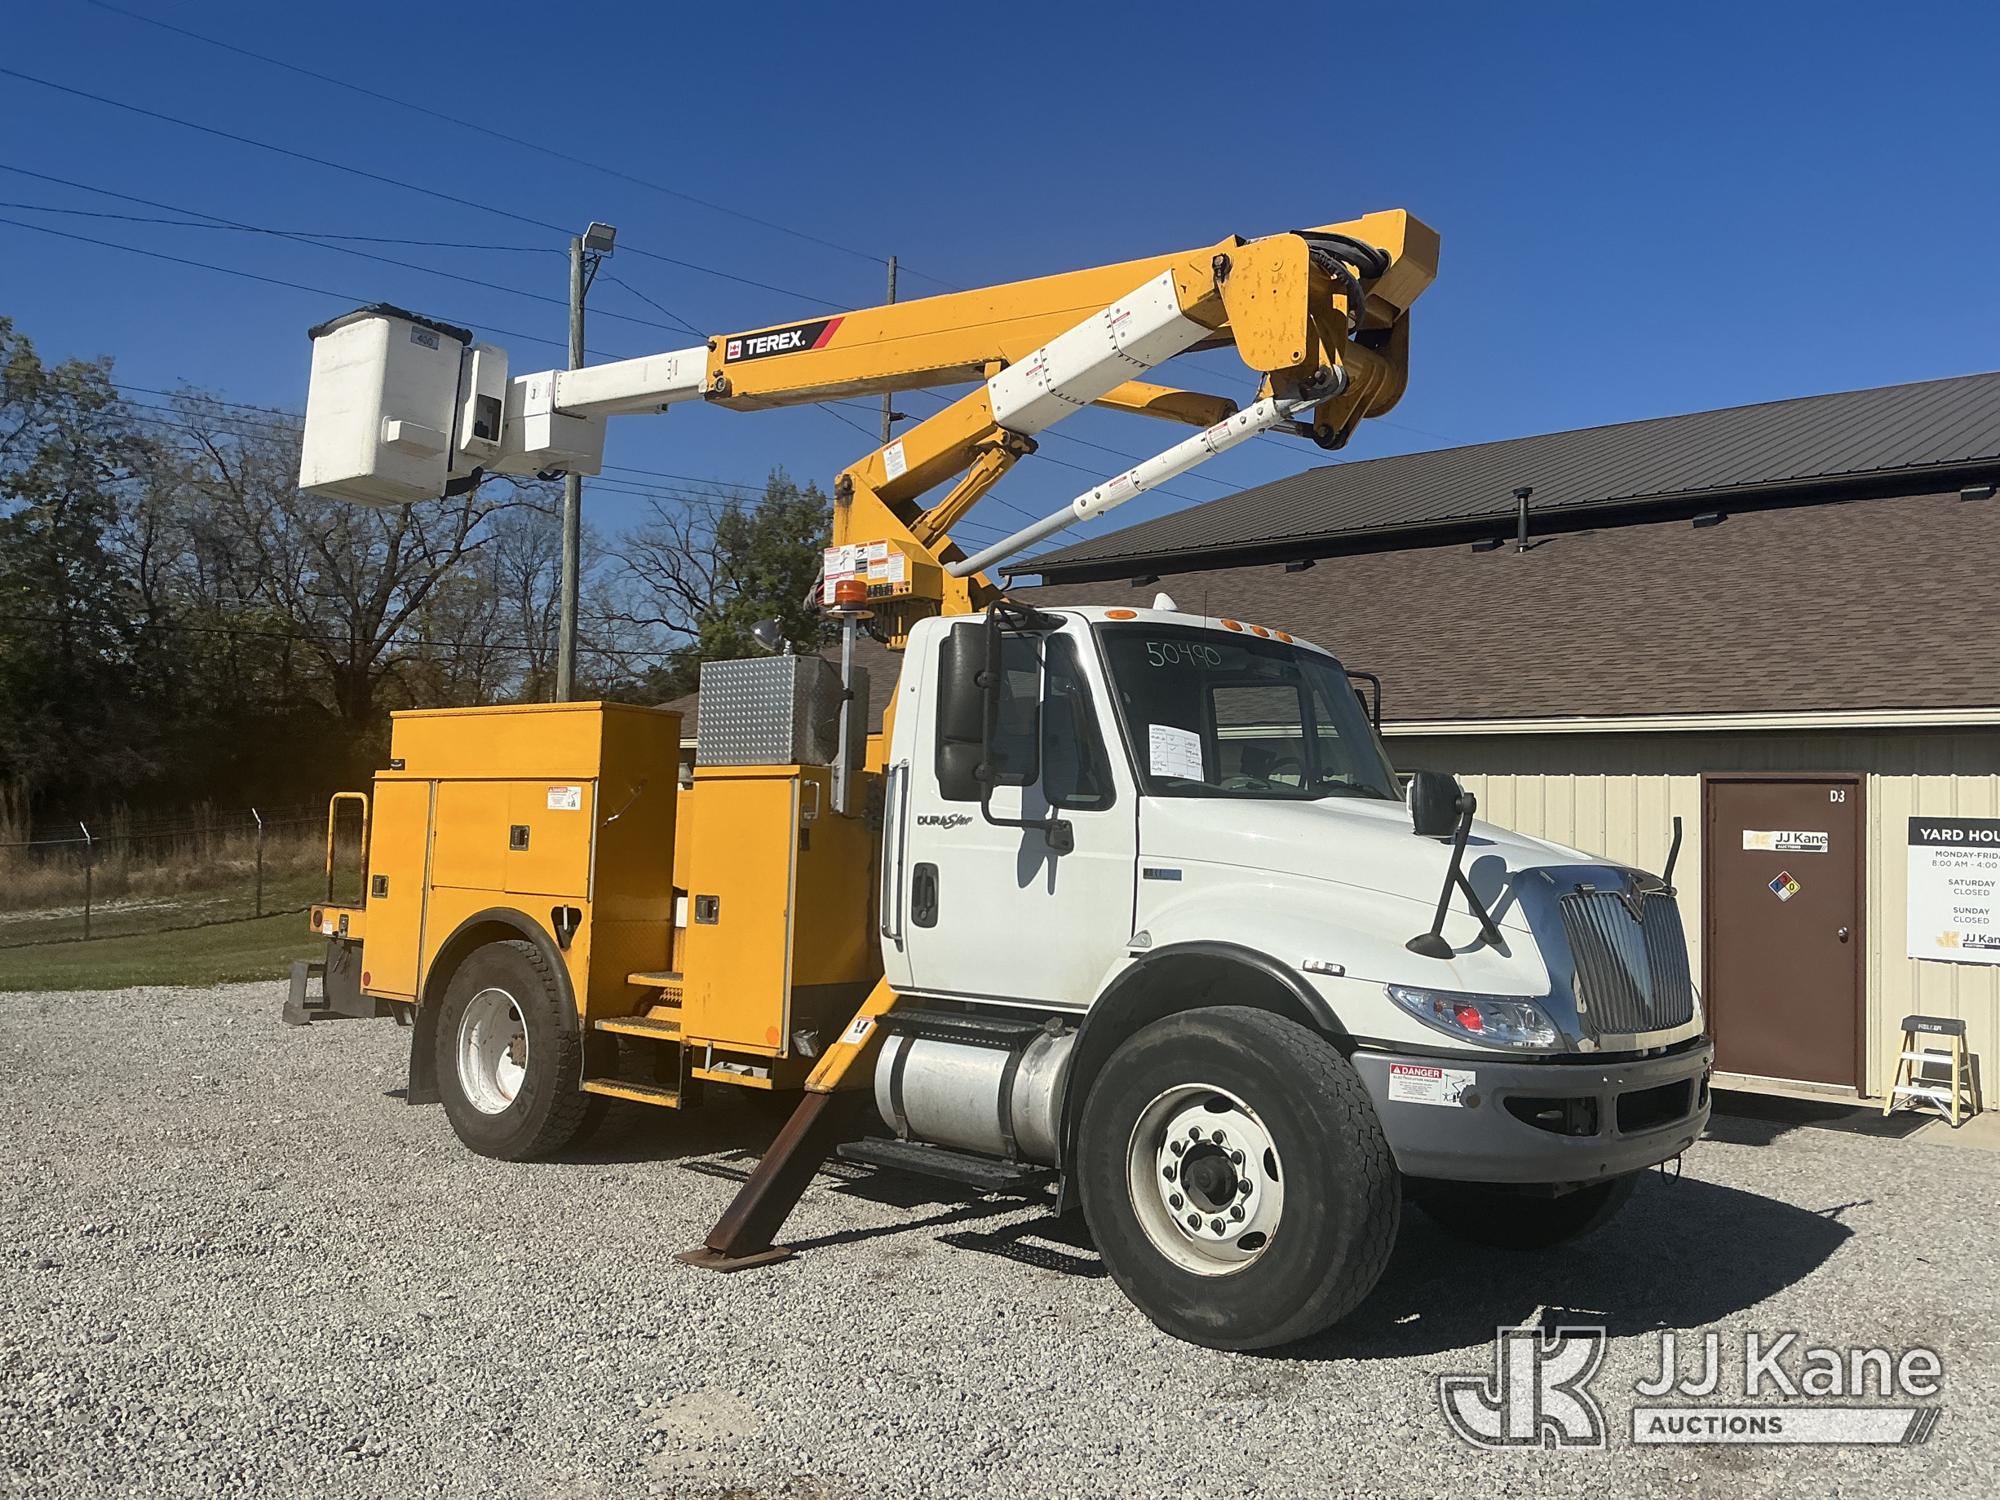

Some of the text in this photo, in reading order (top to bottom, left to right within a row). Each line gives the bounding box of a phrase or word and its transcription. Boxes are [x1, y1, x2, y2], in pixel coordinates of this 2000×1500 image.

[1146, 642, 1221, 668] 50490
[1830, 790, 1845, 802] D3
[1776, 833, 1790, 843] JJ
[1794, 833, 1828, 844] Kane
[1920, 828, 1964, 841] YARD
[1935, 851, 2000, 859] MONDAY-FRID
[1948, 879, 1996, 887] SATURDAY
[1953, 888, 1990, 896] CLOSED
[1953, 906, 1990, 915] SUNDAY
[1953, 916, 1990, 924] CLOSED
[1963, 933, 1975, 942] JJ
[1401, 1067, 1440, 1078] DANGER
